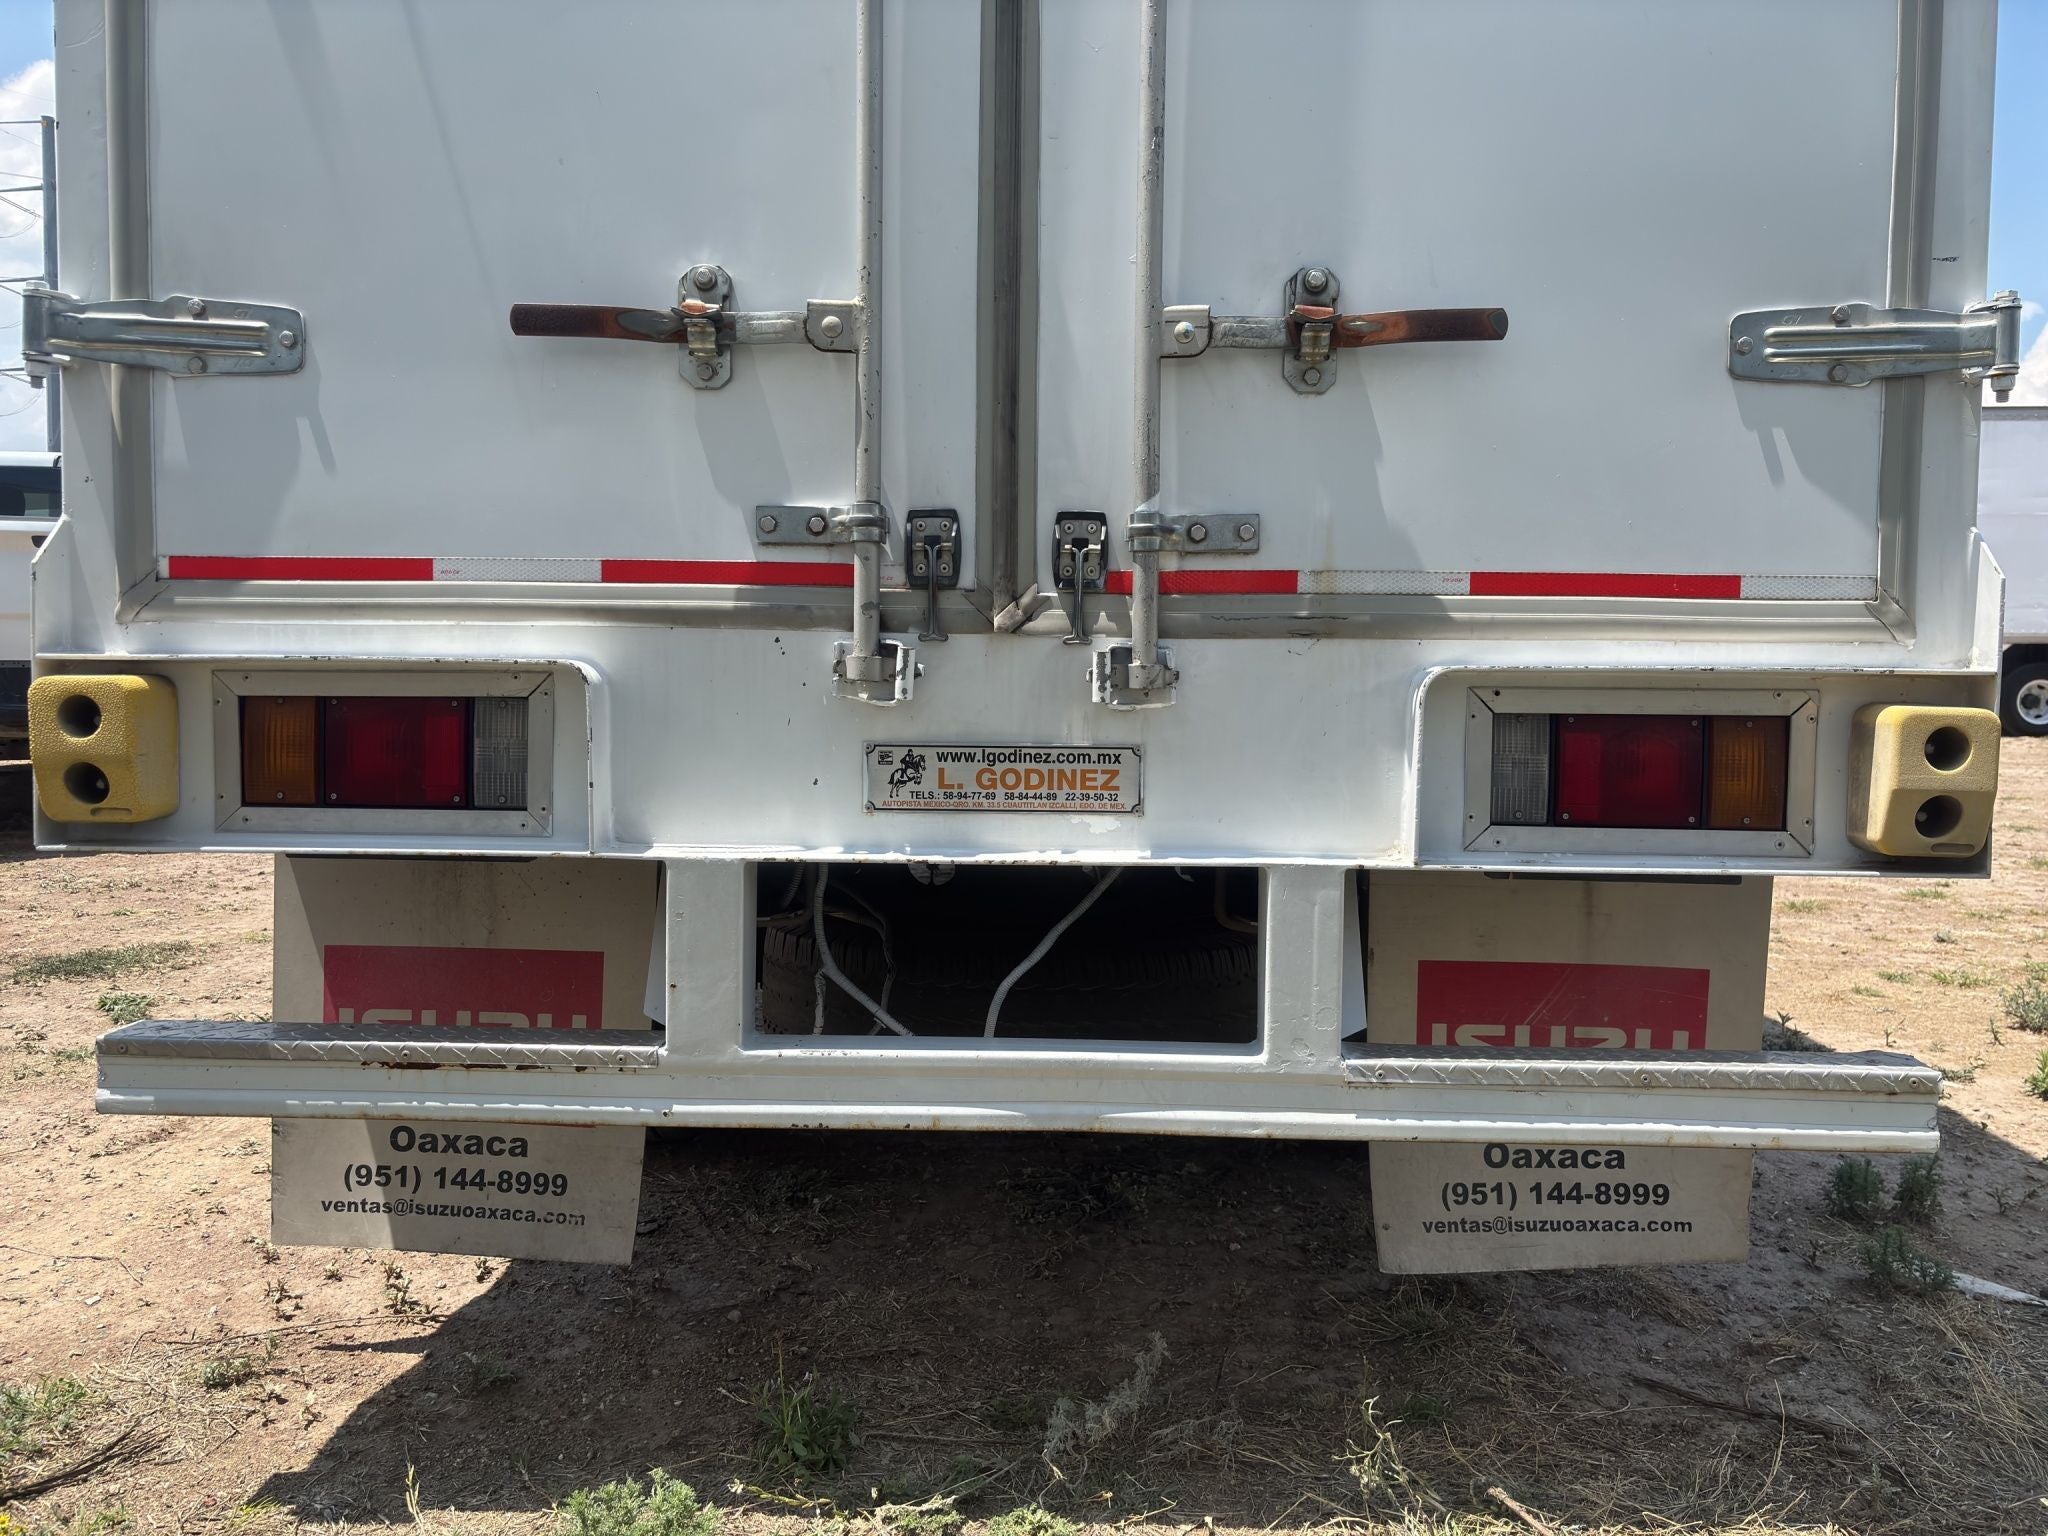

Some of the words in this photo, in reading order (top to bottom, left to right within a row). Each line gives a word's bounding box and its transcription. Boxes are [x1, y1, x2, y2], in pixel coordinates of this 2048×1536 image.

[936, 749, 1122, 766] www.lgodinez.com.mx
[937, 768, 964, 790] L.
[975, 767, 1121, 791] GODINEZ
[882, 800, 921, 808] AUTOPISTA
[909, 791, 940, 800] TELS.:
[943, 791, 997, 800] 58-94-77-69
[1004, 792, 1058, 801] 58-84-44-89
[1065, 793, 1119, 802] 22-39-50-32
[389, 1125, 529, 1158] Oaxaca
[1483, 1142, 1626, 1170] Oaxaca
[344, 1164, 422, 1194] (951)
[433, 1166, 569, 1197] 144-8999
[1441, 1181, 1518, 1211] (951)
[1529, 1182, 1670, 1207] 144-8999
[321, 1198, 586, 1226] ventas@isuzuoaxaca.com
[1422, 1216, 1693, 1235] ventas@isuzuoaxaca.com
